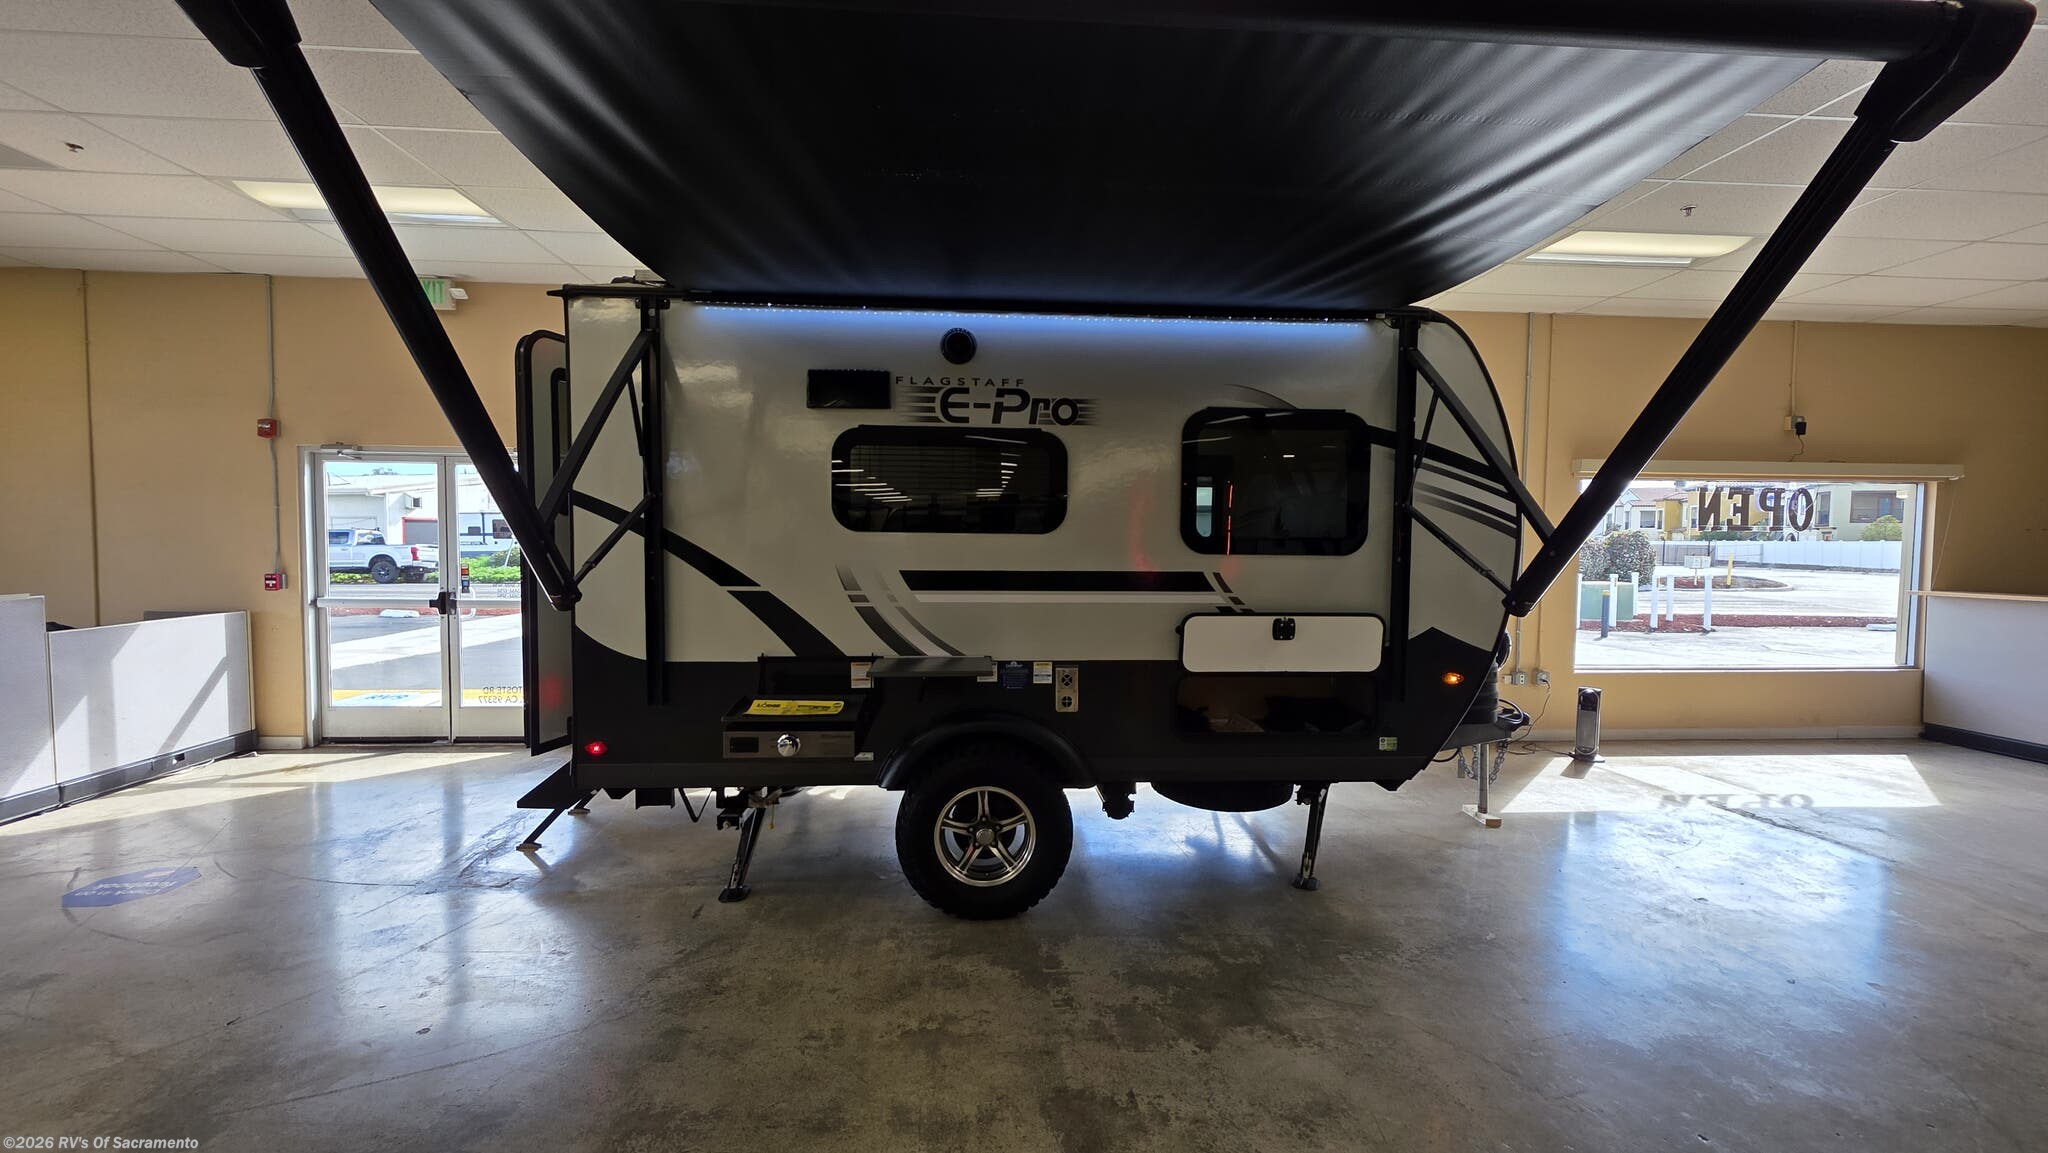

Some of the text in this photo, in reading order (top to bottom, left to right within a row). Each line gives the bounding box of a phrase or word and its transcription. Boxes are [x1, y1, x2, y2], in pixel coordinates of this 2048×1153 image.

[422, 279, 446, 304] XIT
[895, 375, 1025, 387] FLAGSTAFF
[939, 386, 1080, 427] E-Pro
